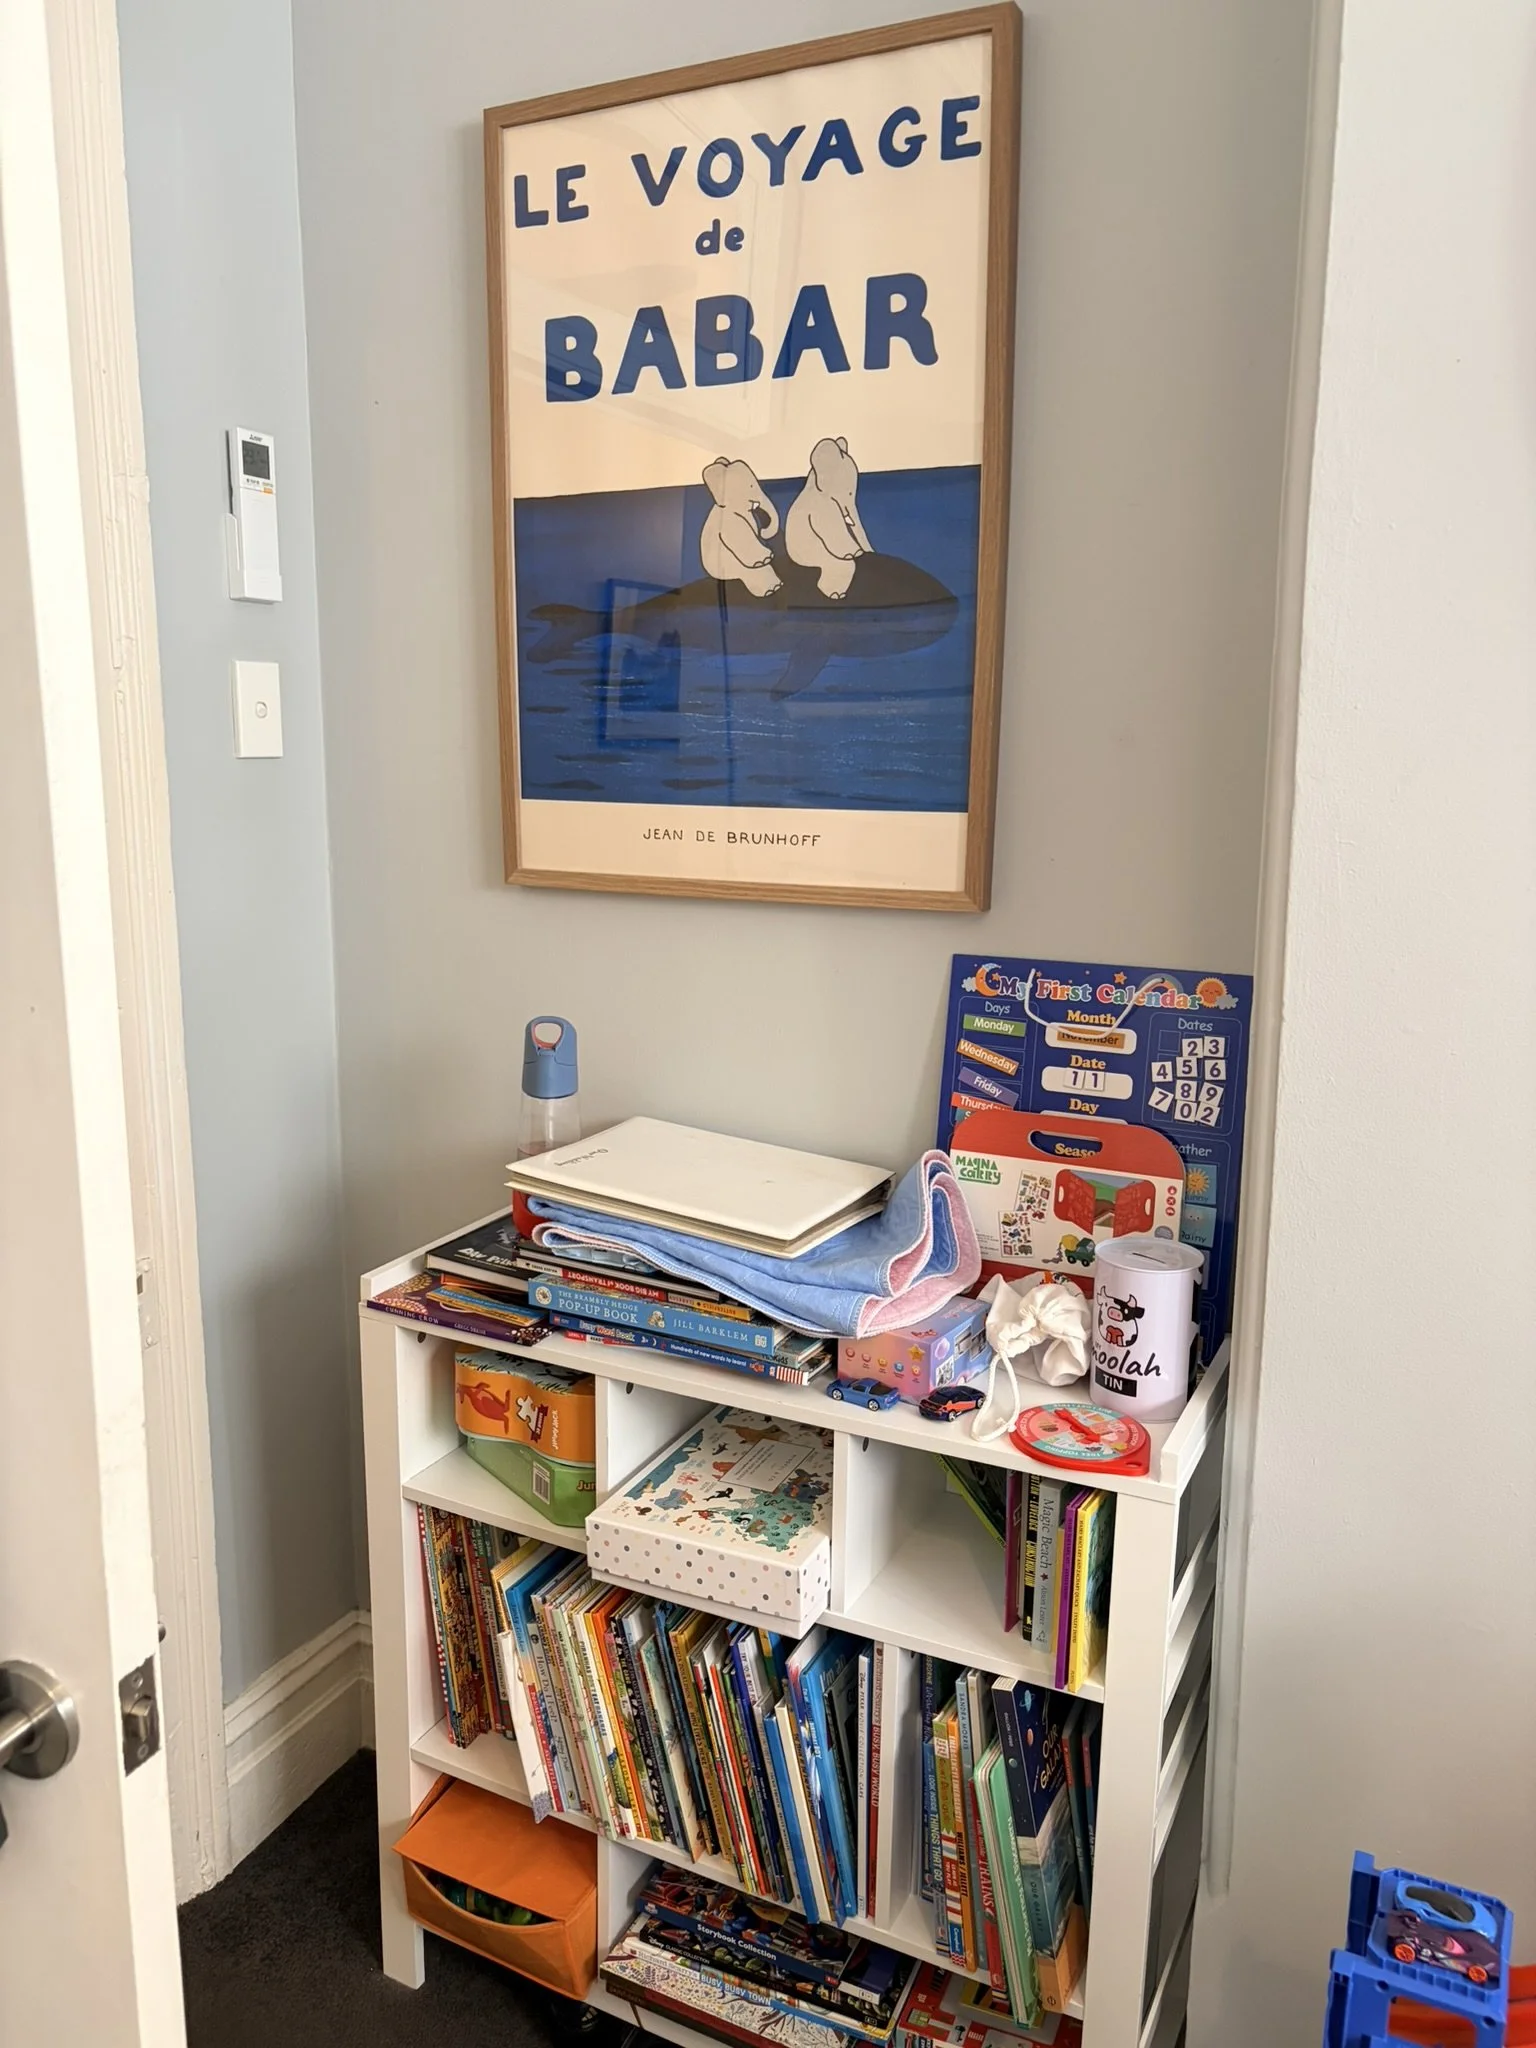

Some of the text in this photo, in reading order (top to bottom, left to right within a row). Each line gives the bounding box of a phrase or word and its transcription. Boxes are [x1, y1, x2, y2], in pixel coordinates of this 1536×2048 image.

[514, 96, 982, 228] LE VOYAGE
[695, 218, 745, 256] de
[545, 273, 939, 403] BABAR
[642, 828, 822, 847] JEAN DE BRUNHOFF
[998, 976, 1202, 1009] My First Calendar
[985, 1001, 1010, 1015] Days
[1067, 1009, 1116, 1025] Month
[974, 1018, 1015, 1033] Monday
[1177, 1018, 1213, 1032] Dates
[960, 1040, 1016, 1075] Wednesday
[1187, 1039, 1219, 1055] 2 3
[1070, 1055, 1106, 1070] Date
[1156, 1059, 1221, 1079] 4 5 6
[974, 1075, 1002, 1097] Friday
[1158, 1083, 1218, 1106] 7 8 9
[1069, 1099, 1099, 1114] Day
[1201, 1108, 1212, 1122] 2
[568, 1272, 606, 1287] TRANSPORT
[614, 1281, 634, 1293] BOOK
[558, 1290, 639, 1312] THE BRAMBLY HEDGE
[559, 1299, 639, 1324] POP-UP BOOK
[385, 1307, 416, 1318] CUNNING
[418, 1315, 439, 1325] CROW
[673, 1319, 748, 1342] JILL BARKLEM
[1103, 1374, 1123, 1391] TIN
[1040, 1498, 1055, 1532] Magic
[1038, 1535, 1053, 1568] Beach
[1024, 1540, 1036, 1586] CONSTRUCTION
[536, 1655, 547, 1676] How
[578, 1640, 592, 1674] PIRANHAS
[541, 1678, 550, 1692] Do
[874, 1658, 882, 1691] Richard
[591, 1692, 599, 1705] EAT
[872, 1693, 881, 1724] Scarry's
[594, 1704, 607, 1737] BANANAS
[958, 1692, 969, 1749] SANDRA MORRIS
[813, 1744, 822, 1760] BOY
[1042, 1723, 1059, 1759] OUR
[871, 1752, 879, 1773] BUSY
[871, 1776, 879, 1806] WORLD
[928, 1774, 942, 1881] LOOK INSIDE THINGS THAT GO
[977, 1858, 993, 1906] TRAINS
[1029, 1880, 1039, 1898] OUR
[697, 1924, 777, 1961] Storybook Collection
[683, 1949, 710, 1965] COLLECTION
[637, 1950, 772, 2007] Richard Scarry's BUSY, BUSY TOWN
